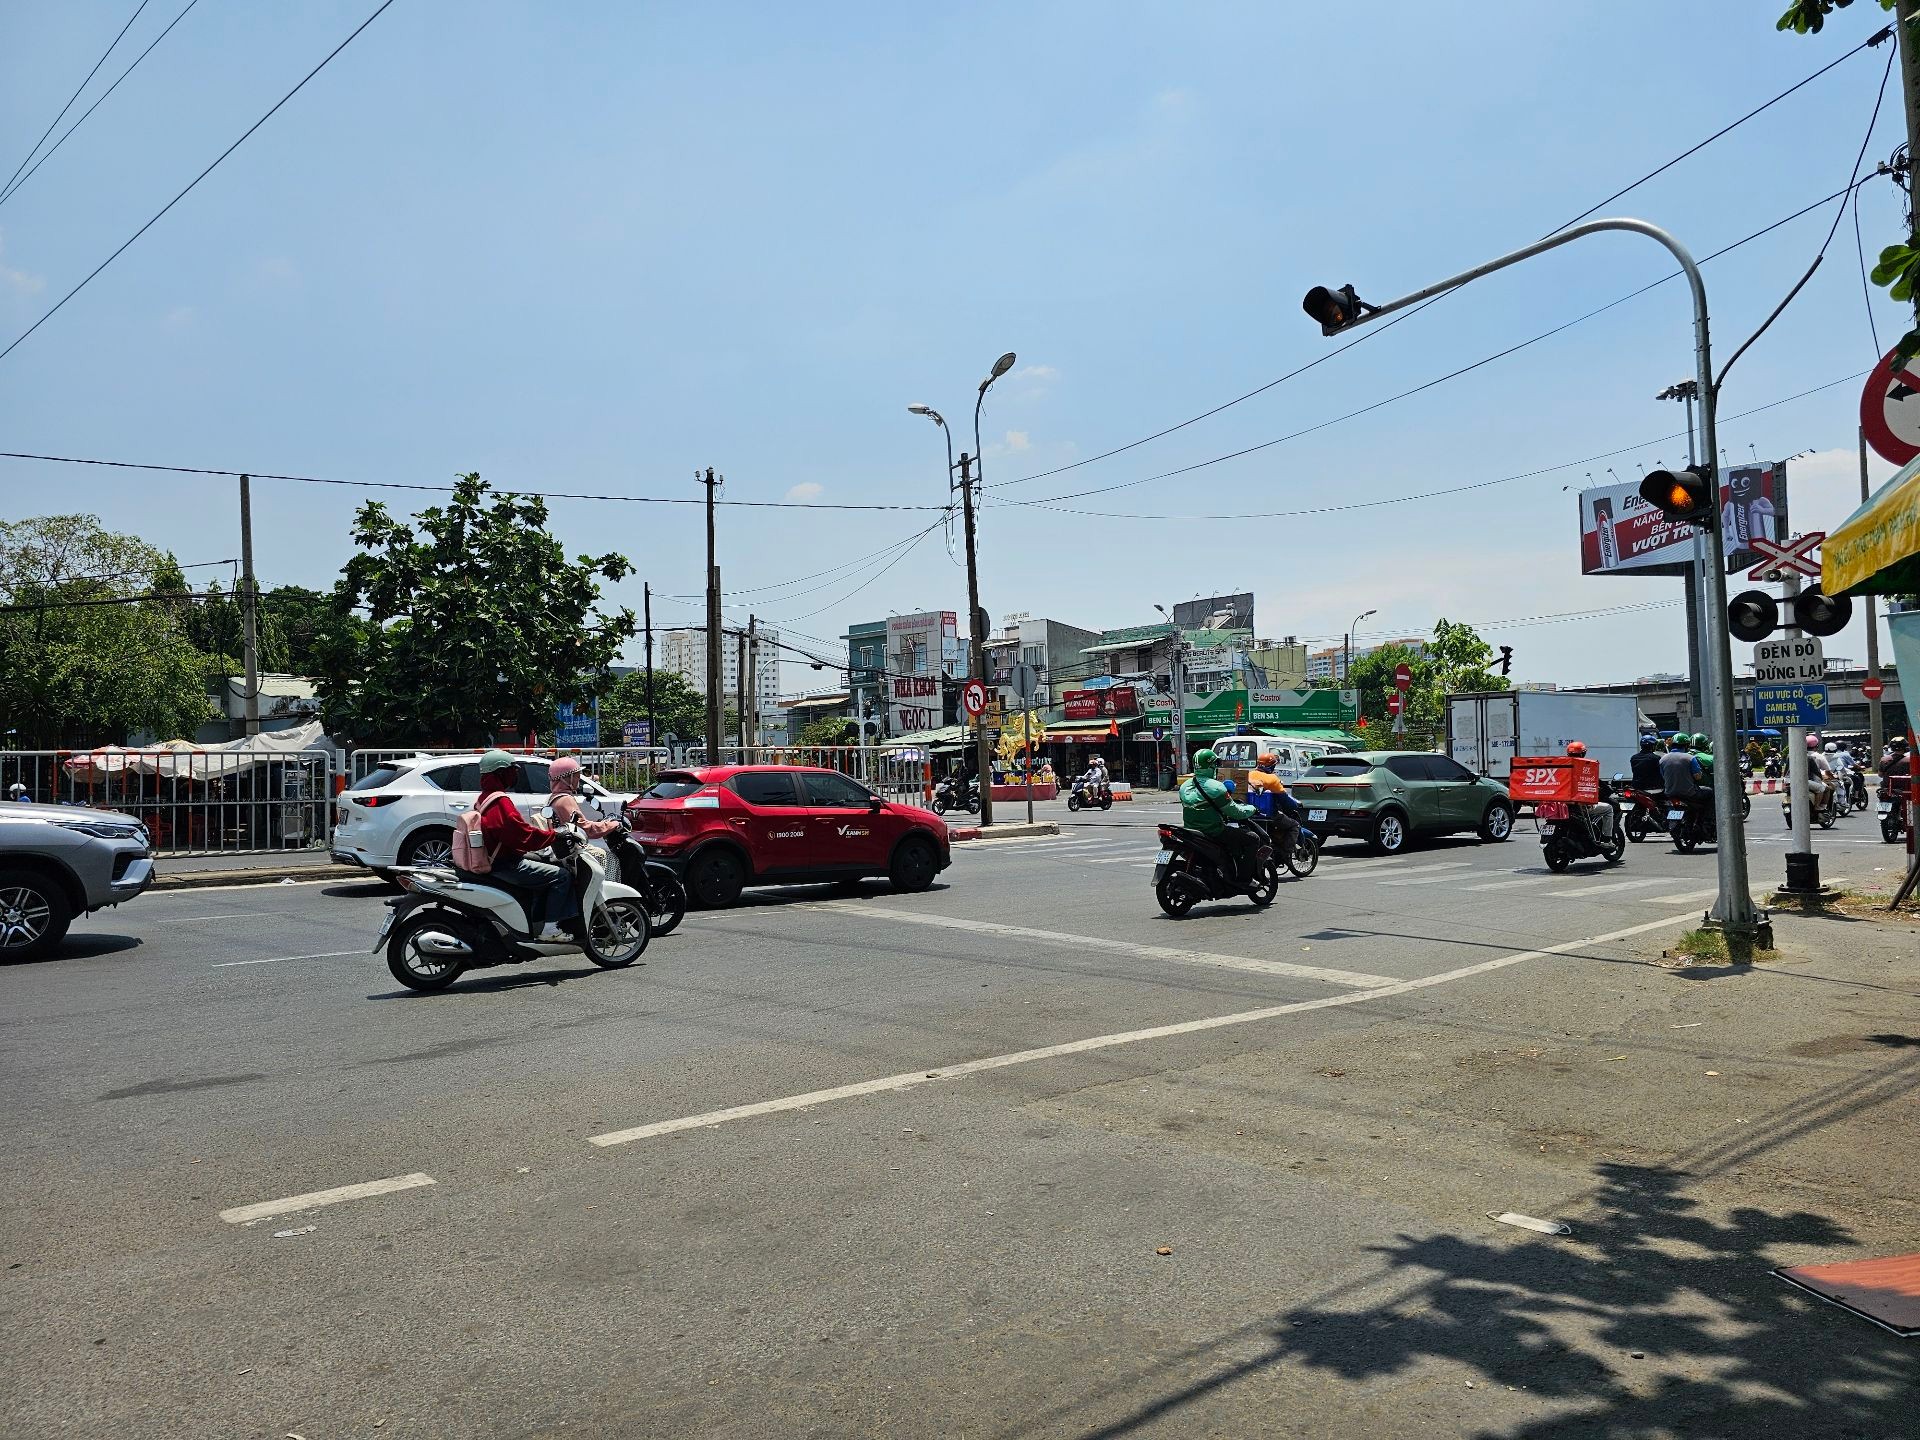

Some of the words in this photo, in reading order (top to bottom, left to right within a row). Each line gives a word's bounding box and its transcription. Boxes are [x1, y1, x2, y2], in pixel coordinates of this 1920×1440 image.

[1738, 504, 1748, 541] Energizer
[1602, 525, 1612, 557] Energizer
[1761, 643, 1790, 660] ĐÈN
[1795, 638, 1814, 657] ĐỎ
[1756, 664, 1796, 681] DỪNG
[1800, 664, 1823, 680] LẠI
[894, 679, 912, 698] NHA
[913, 676, 937, 697] KHOA
[1758, 691, 1774, 700] KHU
[1776, 689, 1791, 701] VỰC
[1260, 694, 1281, 702] Castrol
[1765, 703, 1798, 712] CAMERA
[1525, 767, 1558, 786] SPX
[776, 831, 790, 839] 1900
